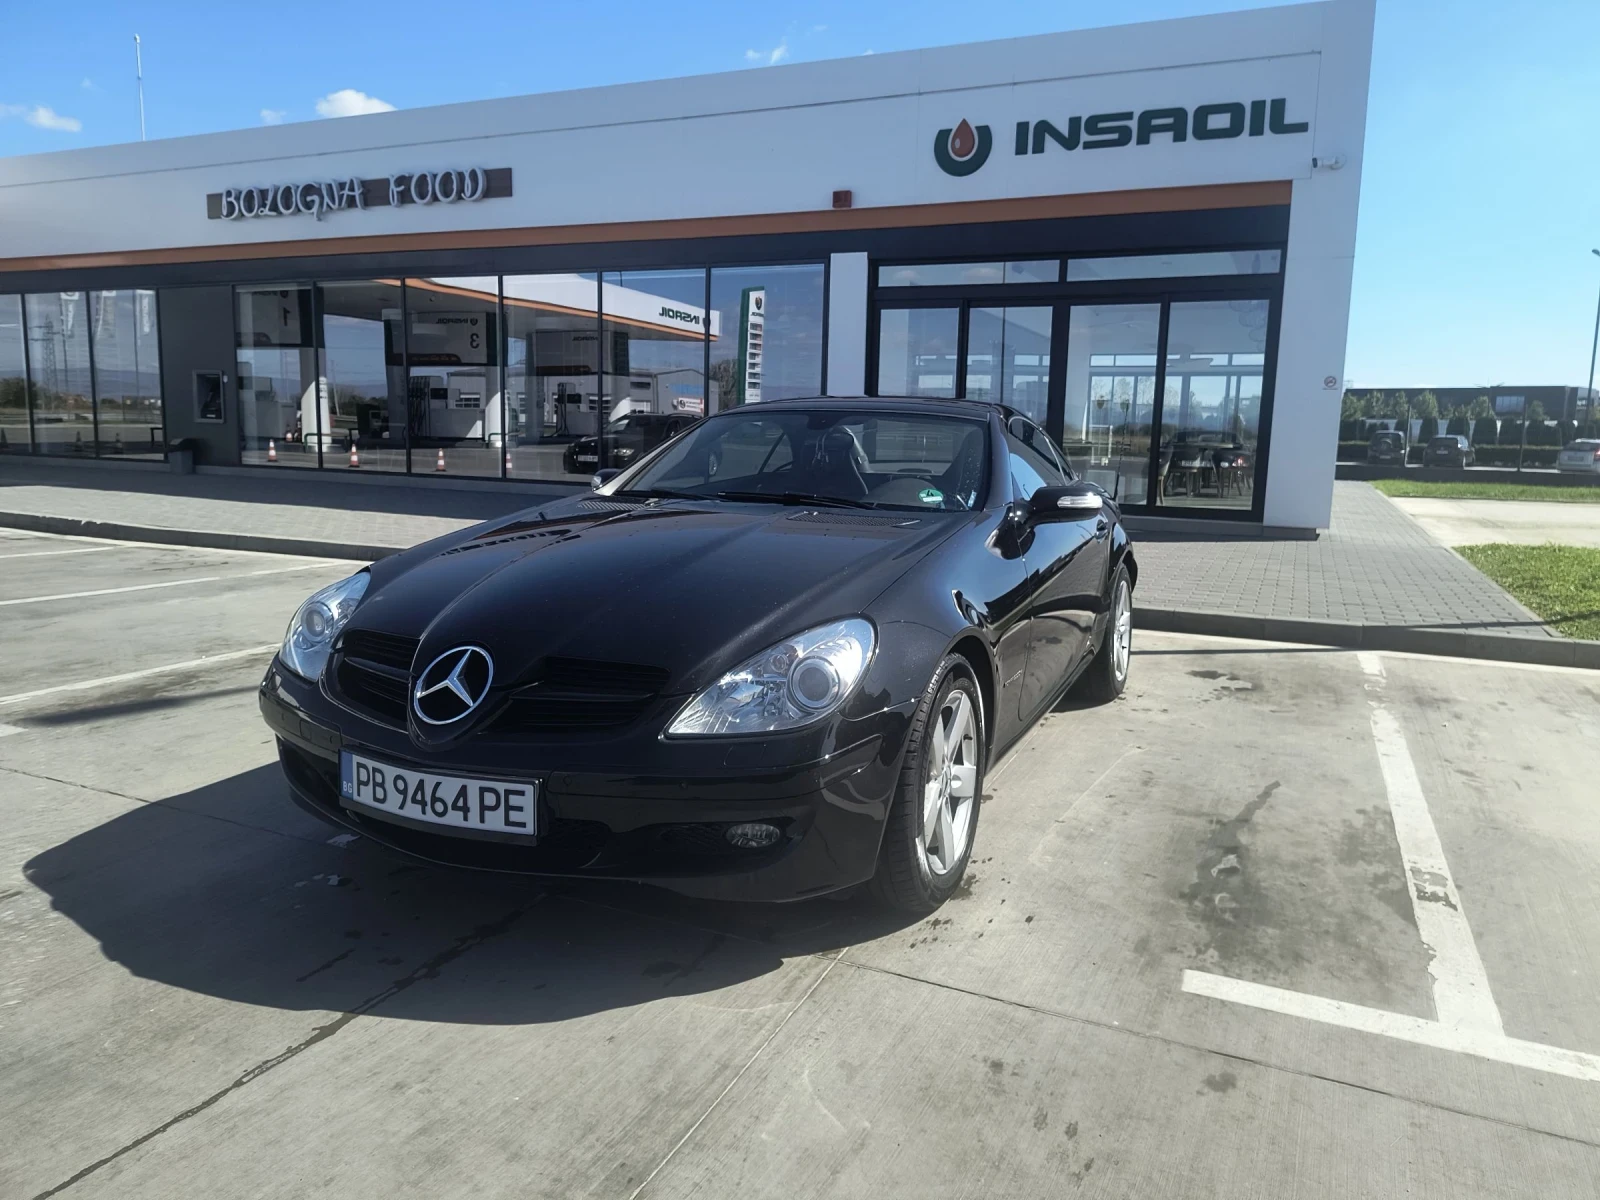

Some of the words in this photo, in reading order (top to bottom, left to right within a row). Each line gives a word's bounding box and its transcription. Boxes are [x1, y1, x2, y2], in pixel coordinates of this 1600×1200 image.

[1014, 97, 1309, 156] INSAOIL
[220, 176, 366, 222] BOLOGNA
[388, 166, 487, 208] FOOD
[342, 780, 353, 794] BG
